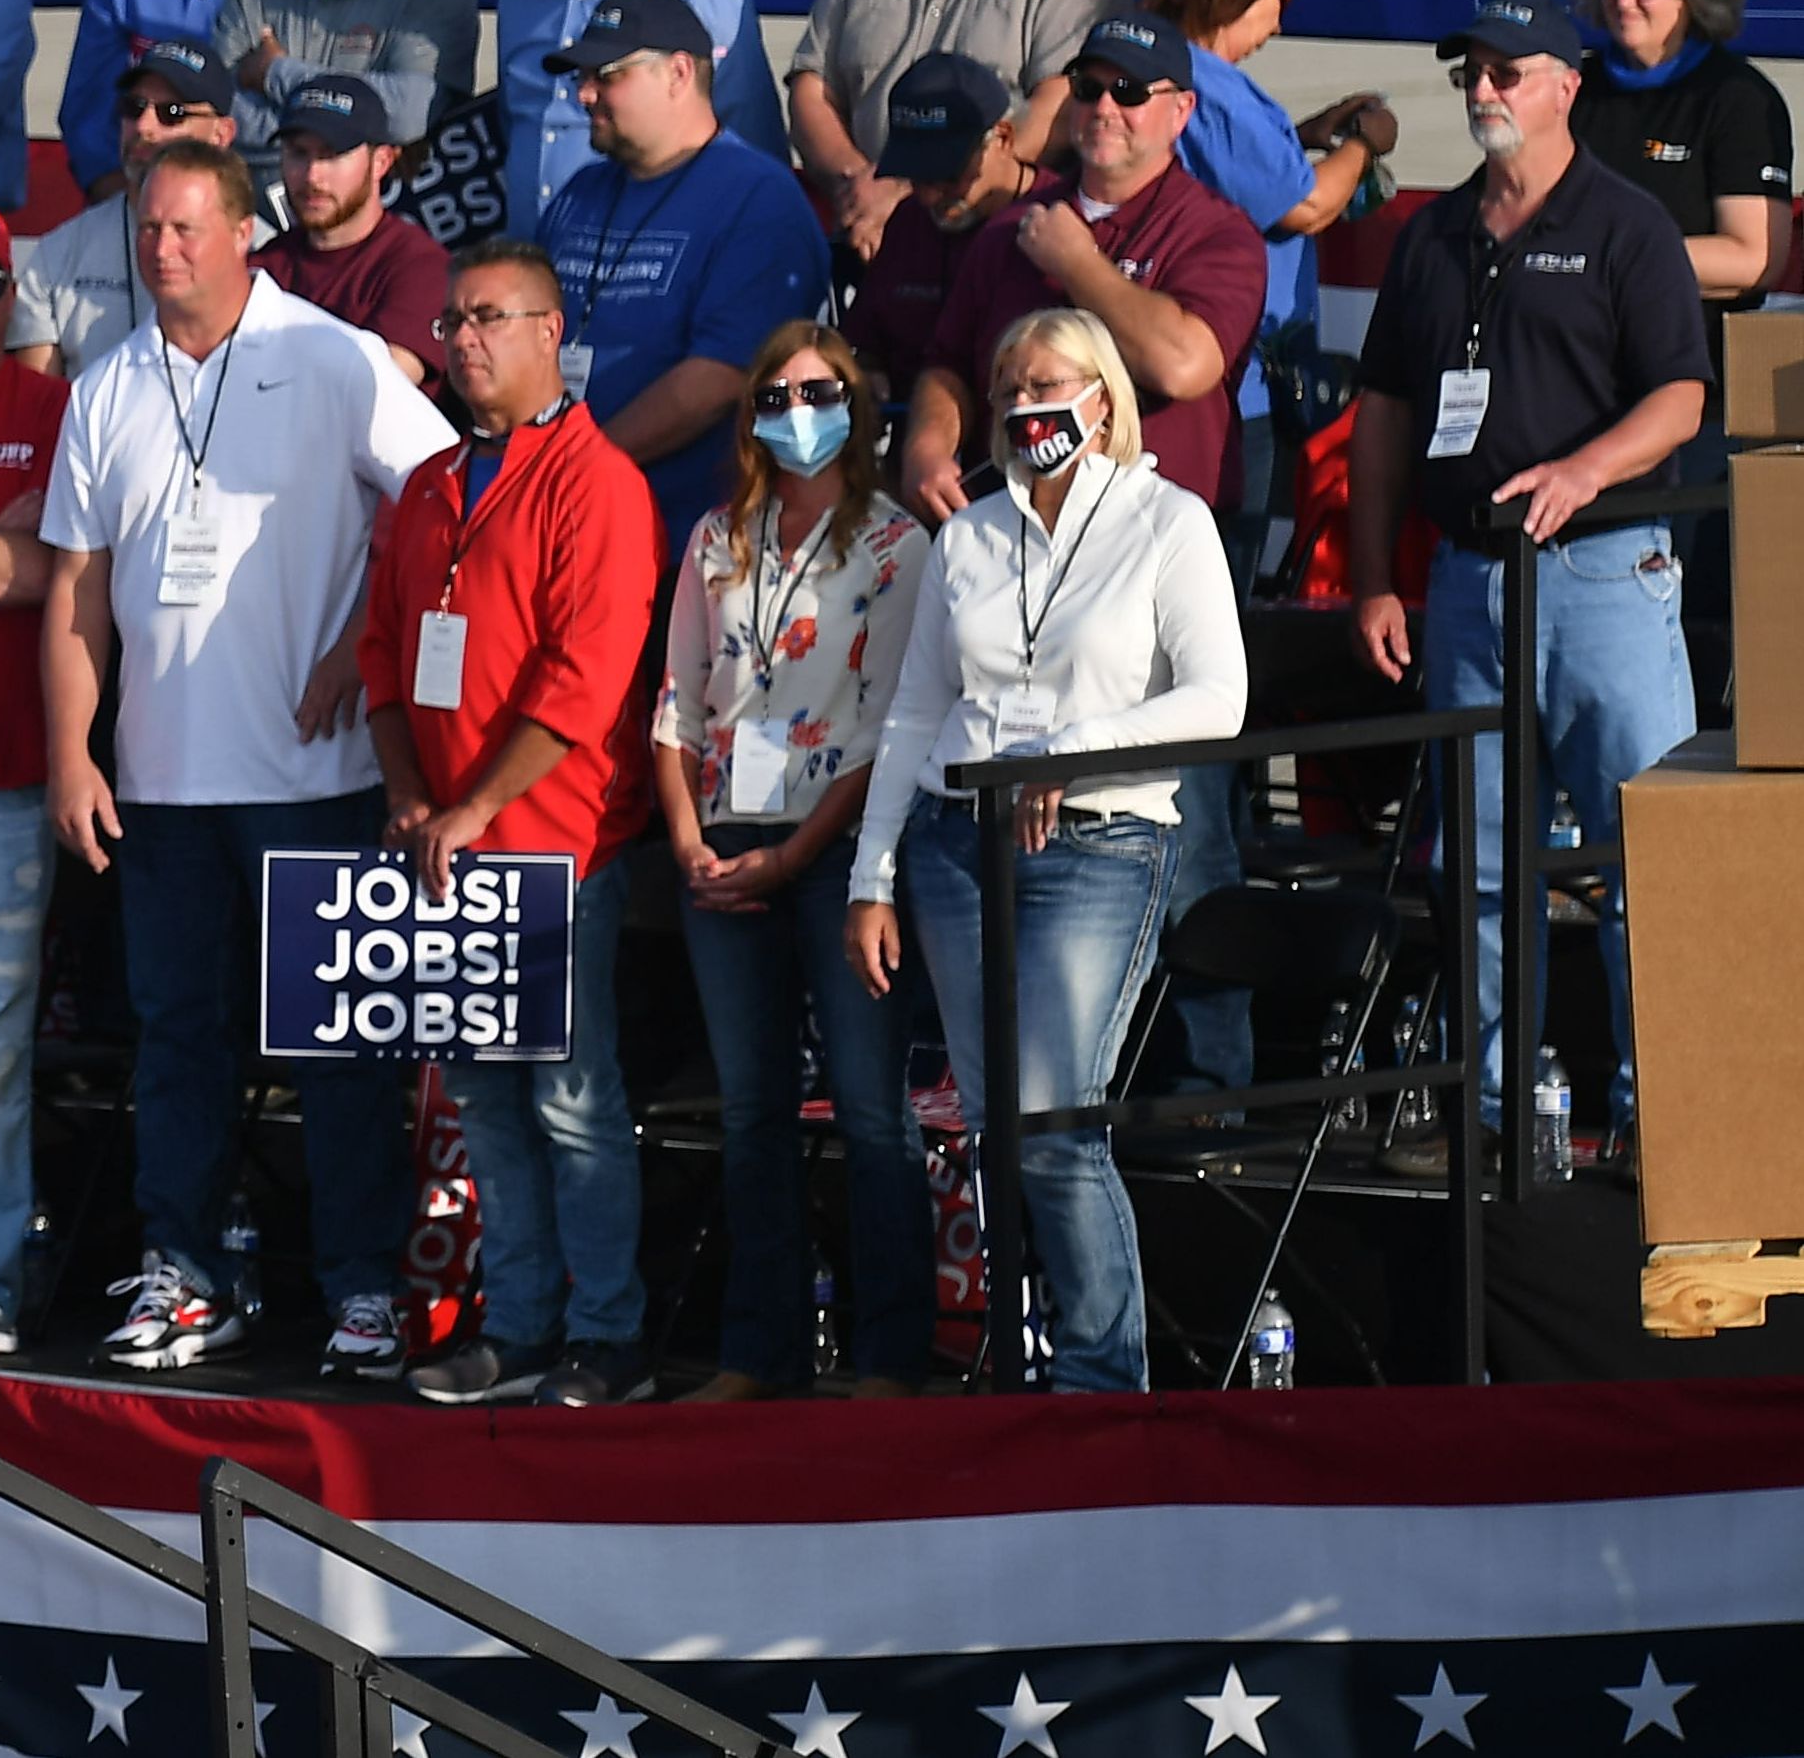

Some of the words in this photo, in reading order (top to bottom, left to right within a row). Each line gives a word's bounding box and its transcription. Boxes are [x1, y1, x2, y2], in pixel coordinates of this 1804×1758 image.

[314, 866, 522, 924] JOBS!
[313, 928, 521, 986] JOBS!
[313, 990, 519, 1046] JOBS!
